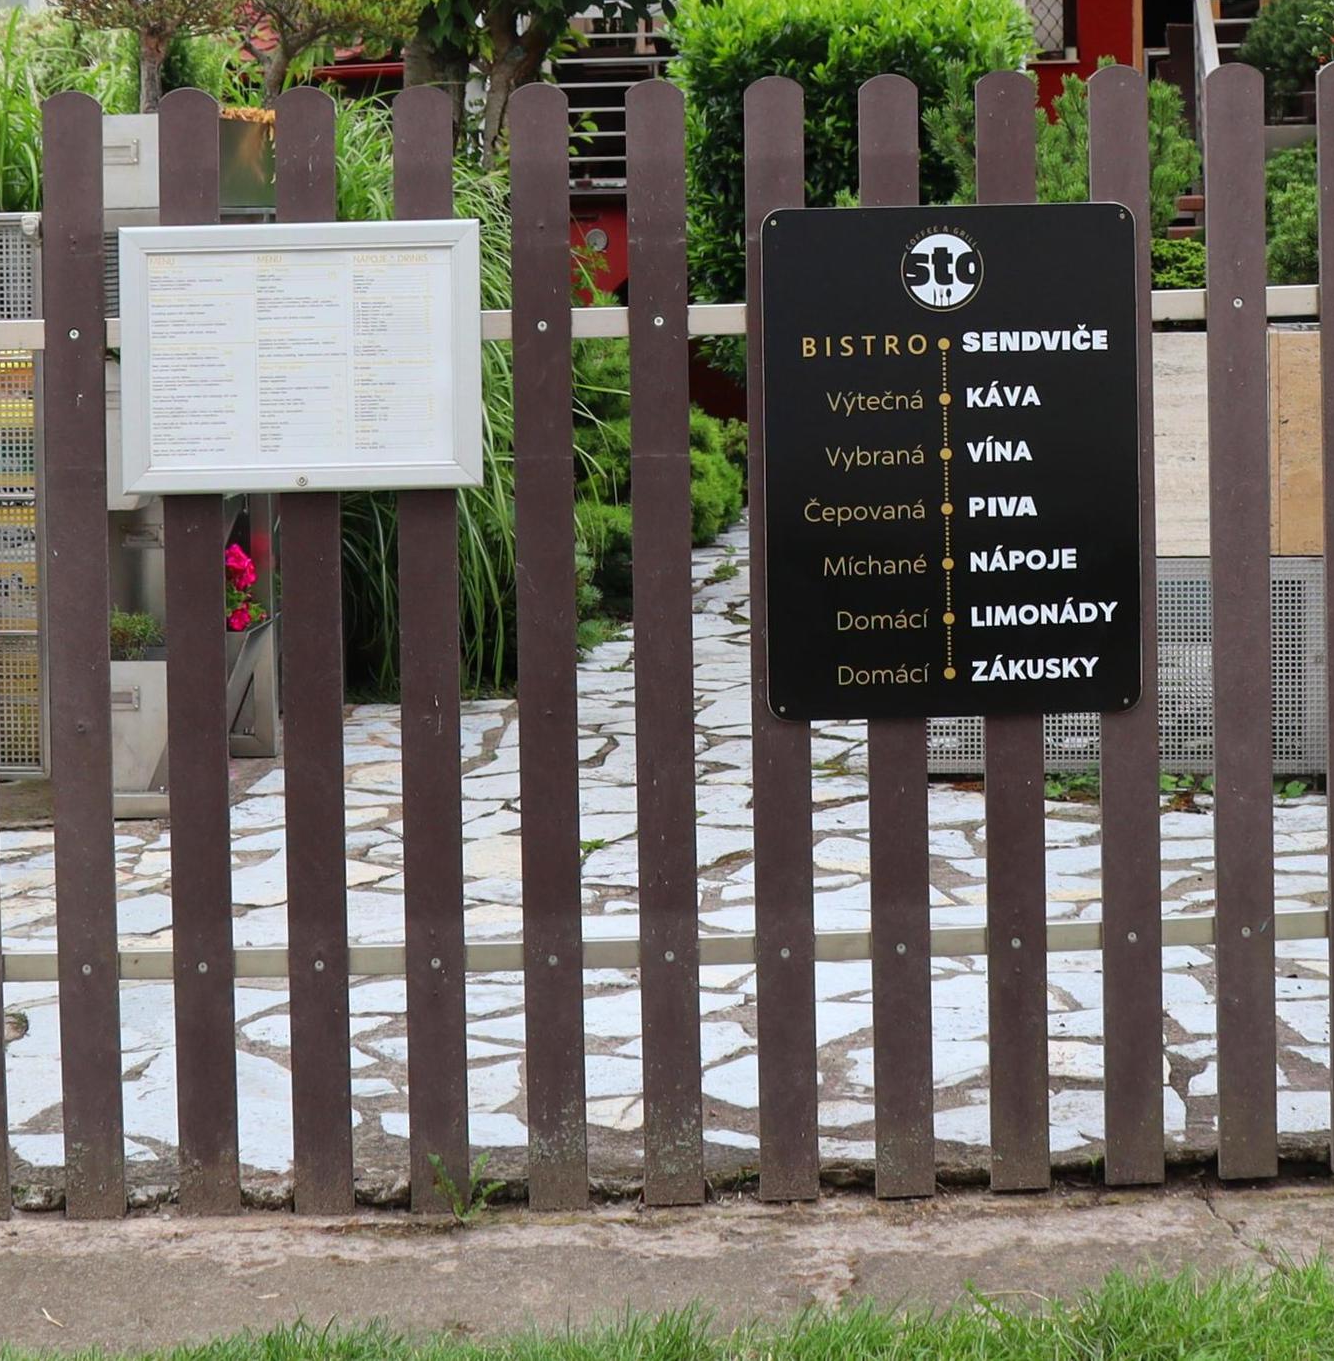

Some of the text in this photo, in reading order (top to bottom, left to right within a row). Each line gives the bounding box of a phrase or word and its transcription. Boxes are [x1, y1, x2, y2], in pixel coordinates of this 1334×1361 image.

[802, 334, 927, 358] BISTRO
[962, 324, 1109, 353] SENDVIČE
[826, 389, 924, 417] Výtečná
[966, 381, 1041, 408] KÁVA
[825, 444, 925, 472] Vybraná
[966, 436, 1033, 463] VÍNA
[804, 497, 926, 527] Čepovaná
[968, 496, 1038, 518] PIVA
[823, 554, 927, 577] Míchané
[969, 544, 1077, 572] NÁPOJE
[837, 608, 929, 631] Domácí
[970, 596, 1118, 627] LIMONÁDY
[837, 663, 930, 686] Domácí
[971, 654, 1100, 682] ZÁKUSKY
